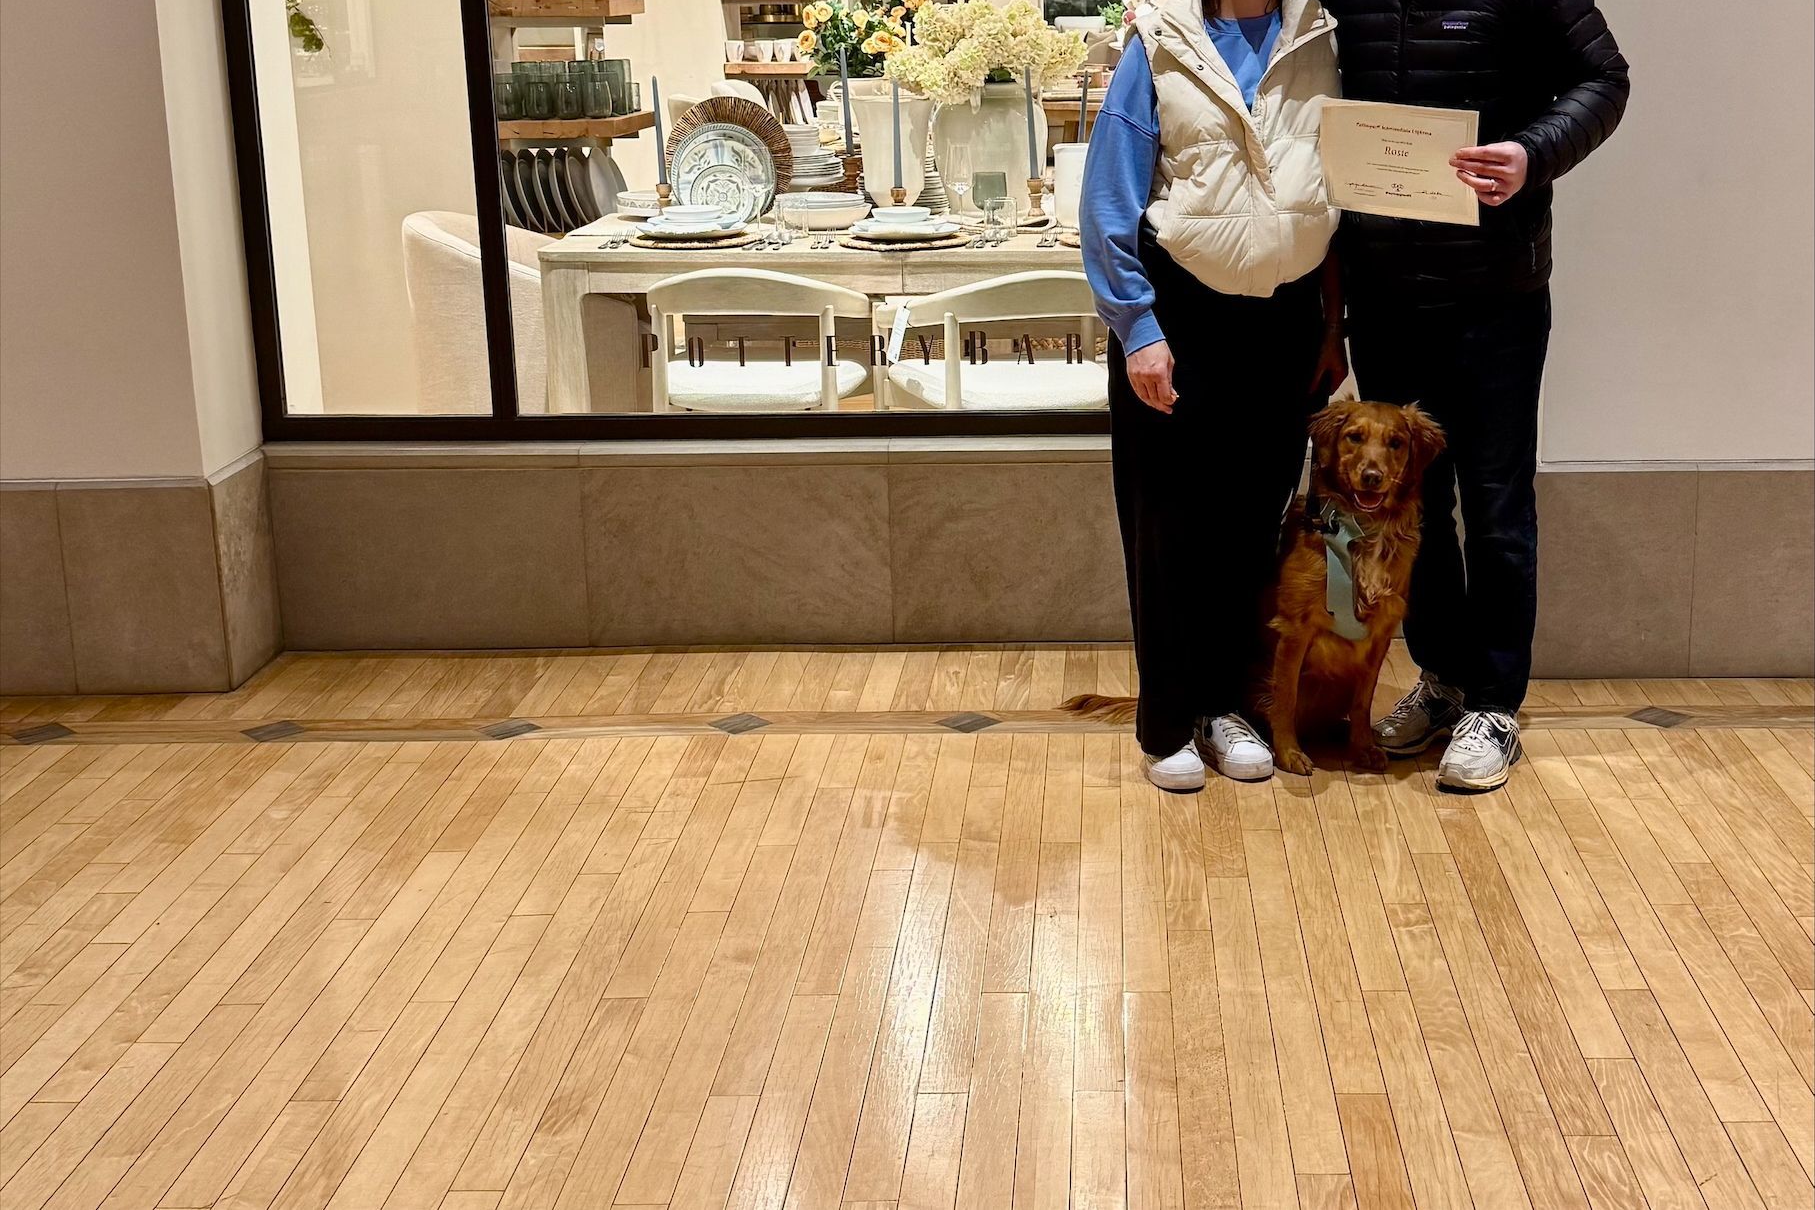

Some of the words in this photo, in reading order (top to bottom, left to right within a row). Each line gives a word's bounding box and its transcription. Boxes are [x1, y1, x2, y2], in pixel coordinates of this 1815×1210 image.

[1384, 146, 1409, 158] Rosie
[641, 333, 934, 368] POTTERY
[969, 330, 1084, 366] BAR
